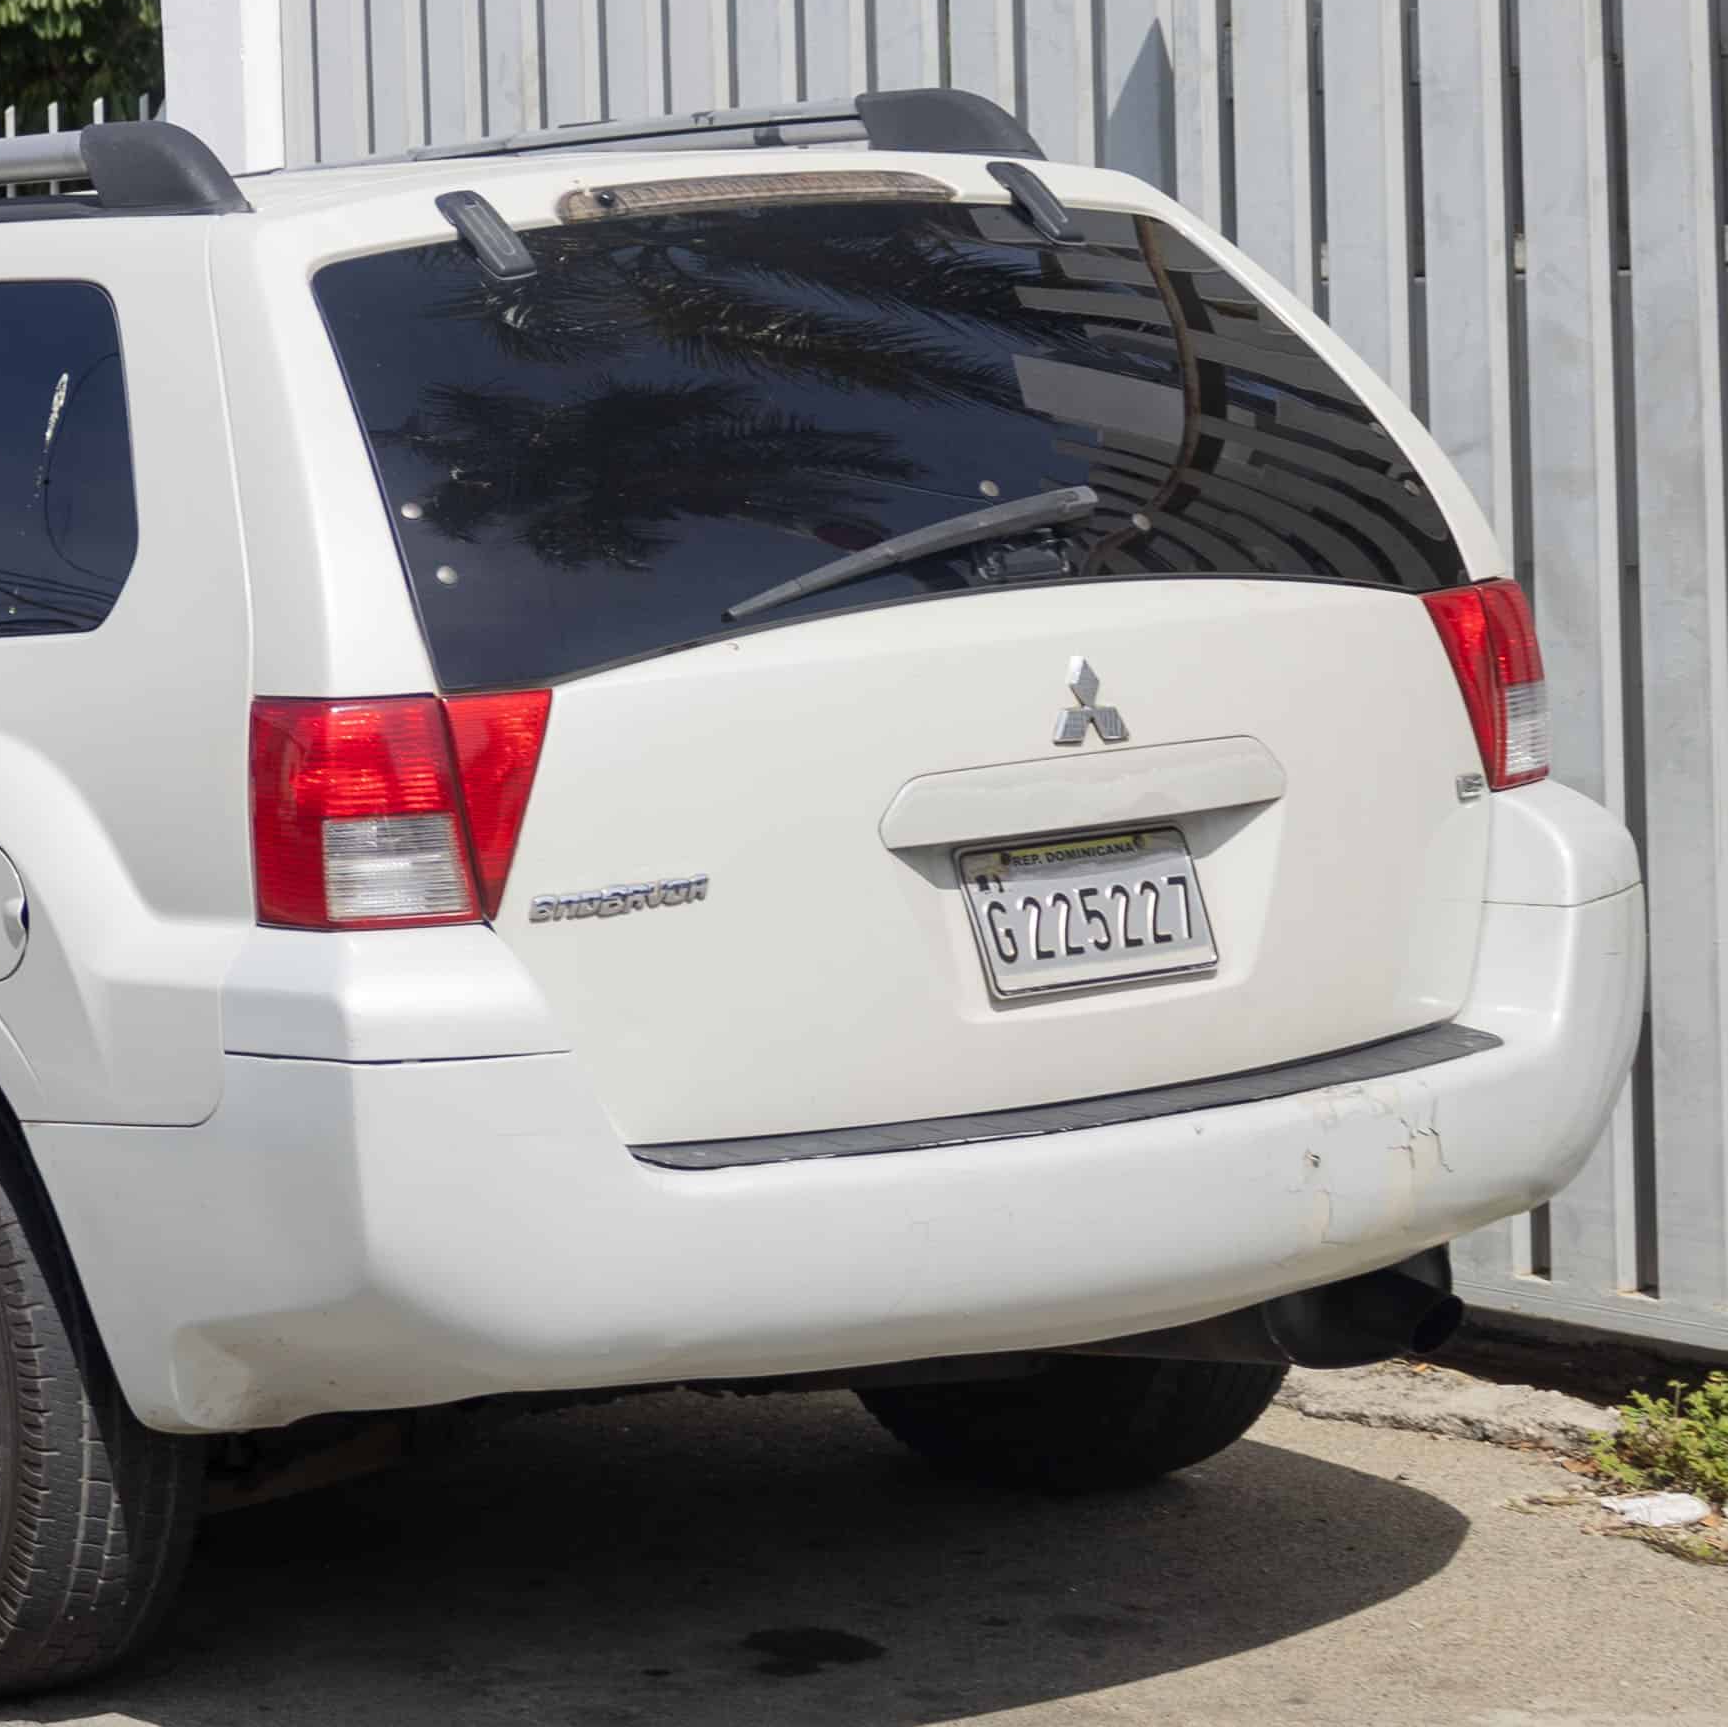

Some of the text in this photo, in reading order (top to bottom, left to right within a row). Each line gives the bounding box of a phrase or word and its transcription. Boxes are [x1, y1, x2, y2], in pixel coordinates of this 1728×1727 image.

[1012, 842, 1135, 868] REP. DOMINICANA
[985, 875, 1194, 965] G225227
